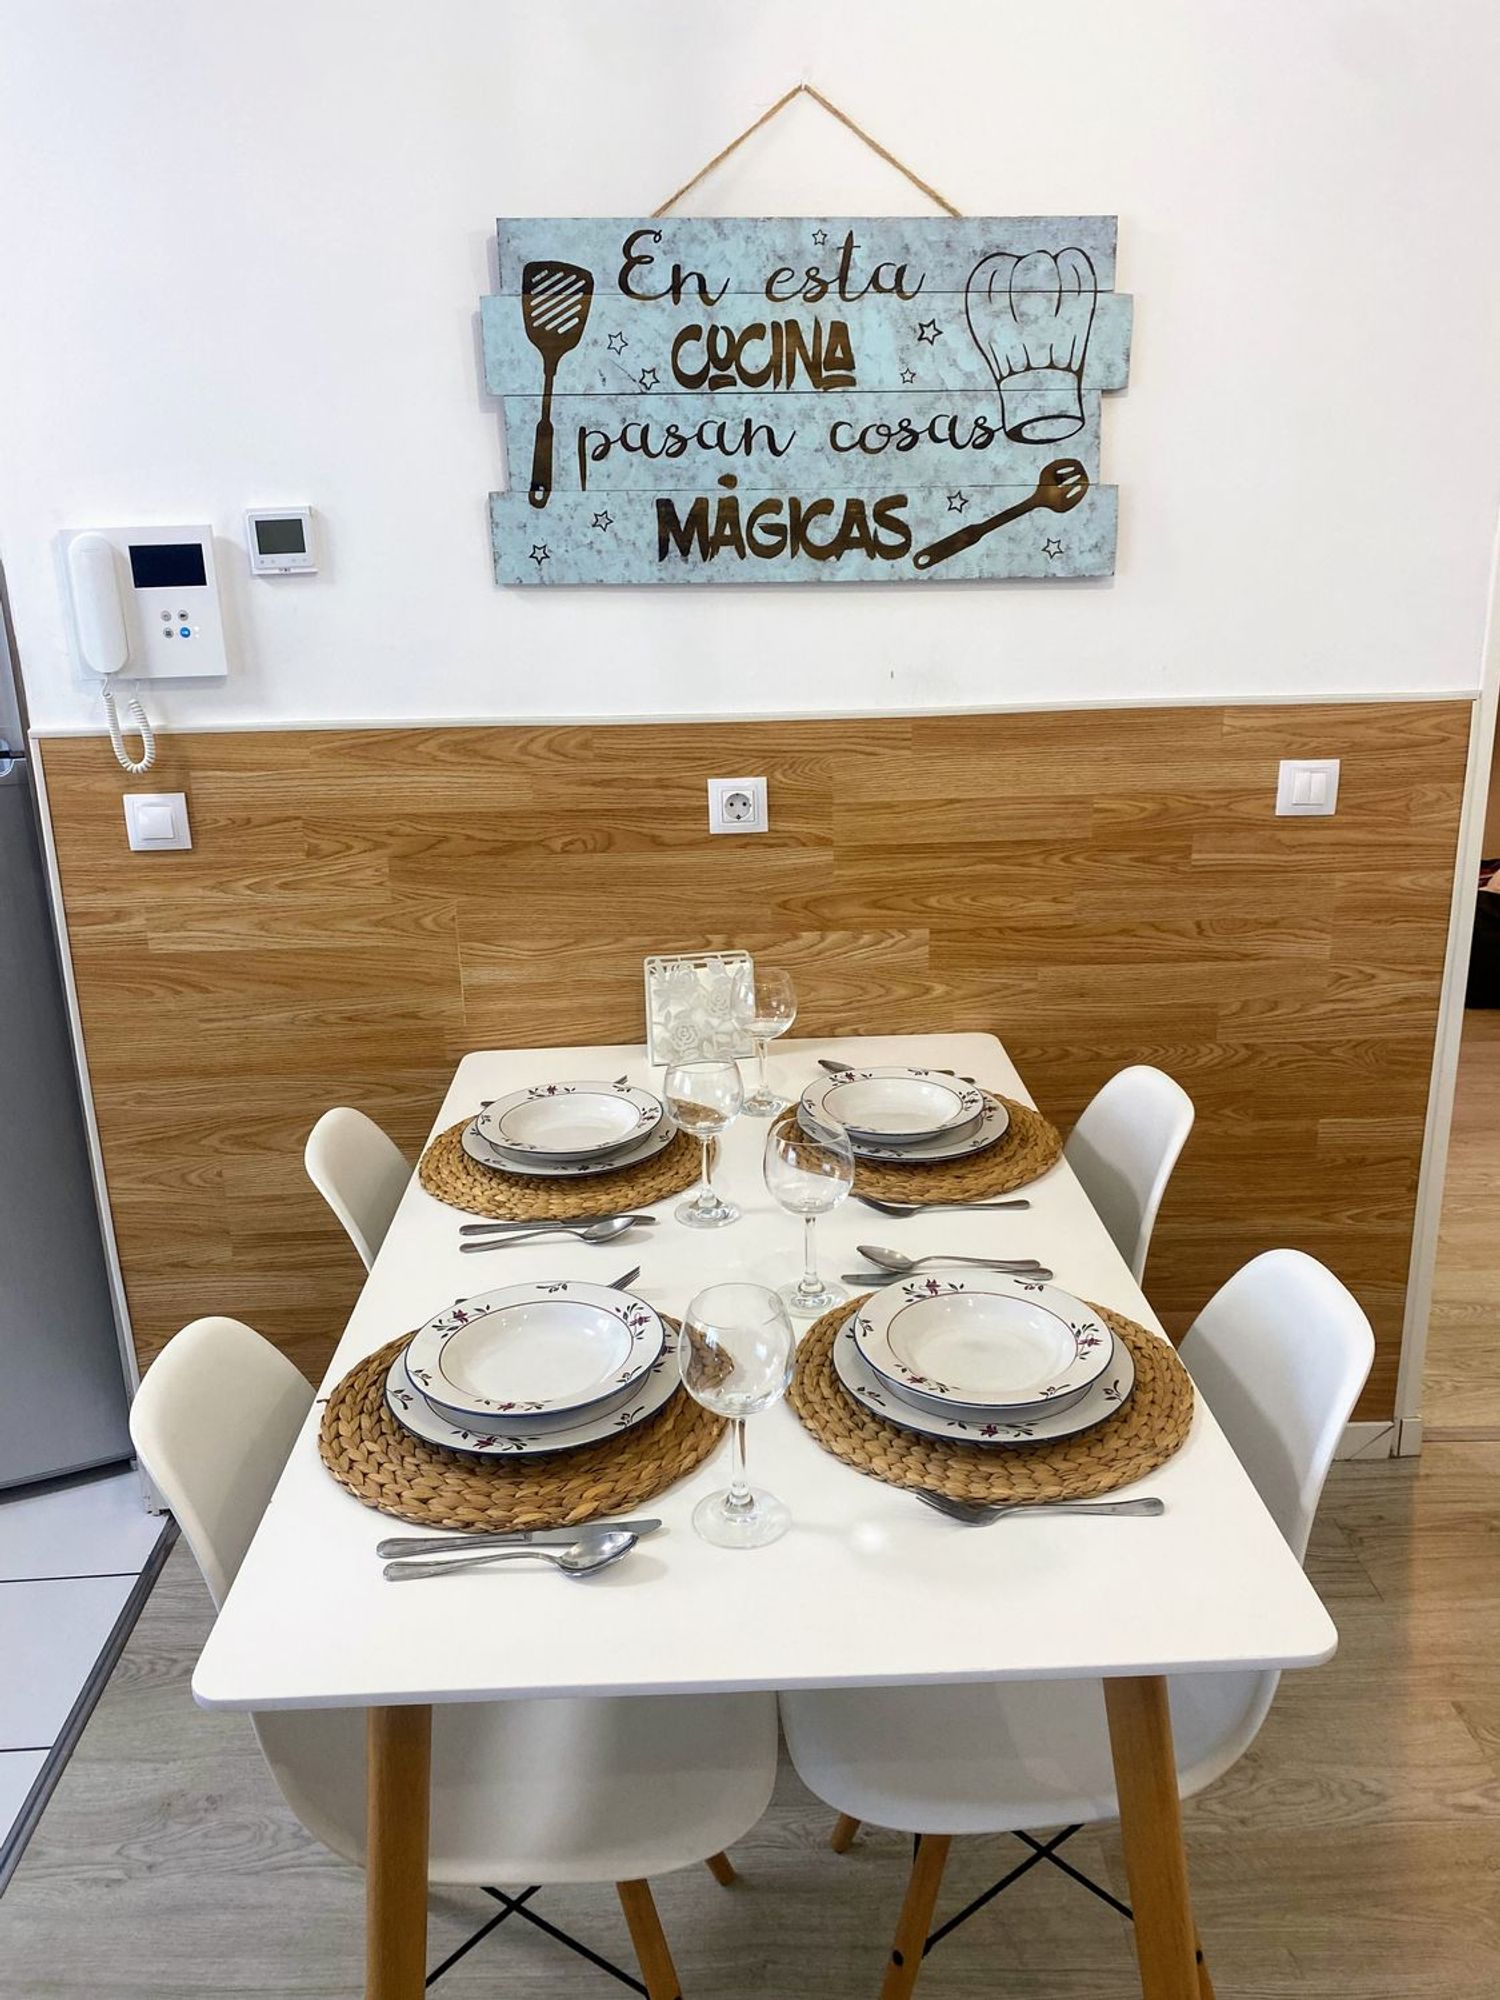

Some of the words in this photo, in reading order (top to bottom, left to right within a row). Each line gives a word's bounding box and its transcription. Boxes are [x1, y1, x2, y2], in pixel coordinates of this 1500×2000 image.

[618, 229, 731, 306] En
[765, 229, 927, 304] esta
[671, 317, 856, 391] COCINA
[577, 417, 796, 491] pasan
[829, 411, 1003, 454] cosas
